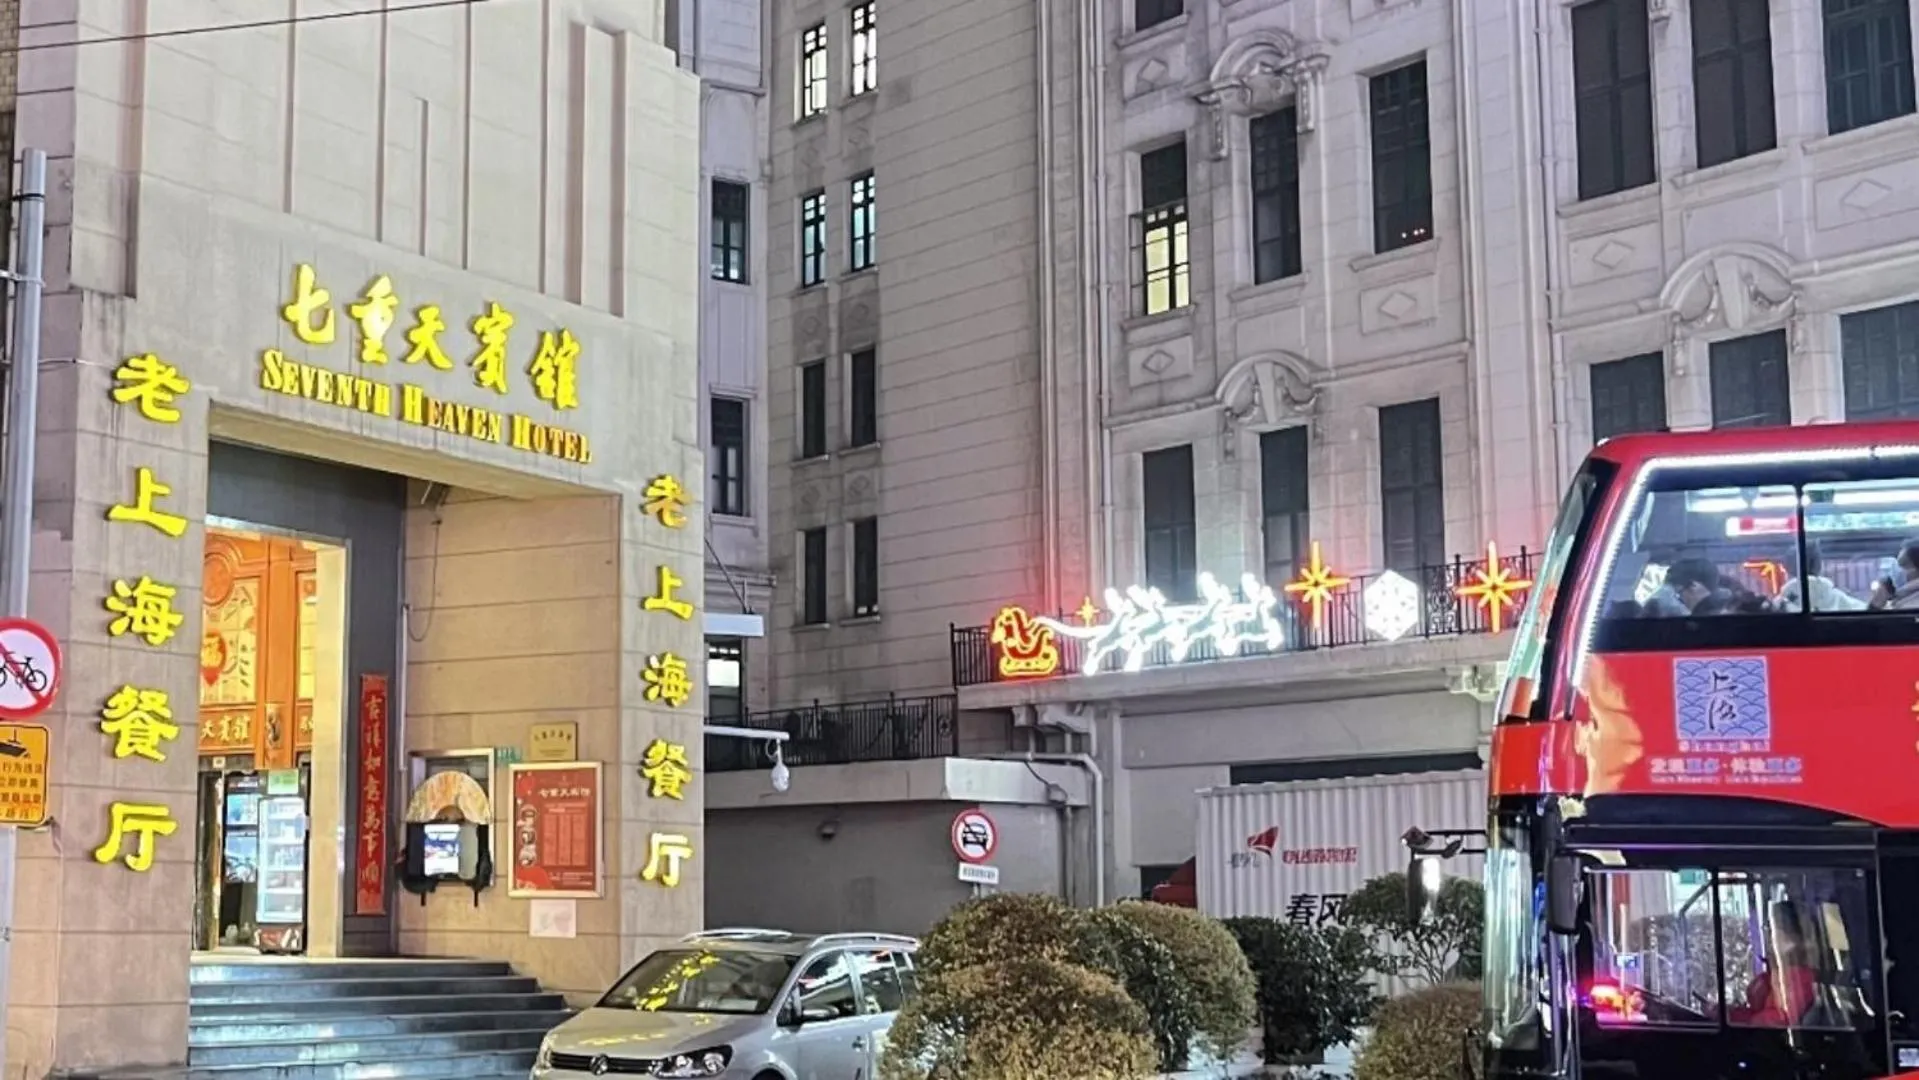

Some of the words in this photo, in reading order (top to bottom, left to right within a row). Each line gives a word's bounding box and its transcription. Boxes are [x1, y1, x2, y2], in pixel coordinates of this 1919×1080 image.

[261, 349, 392, 417] SEVENTH
[402, 383, 503, 444] HEAVEN
[511, 413, 594, 464] HOTEL
[95, 353, 191, 874] 老上海餐厅
[643, 475, 696, 887] 老上海餐厅
